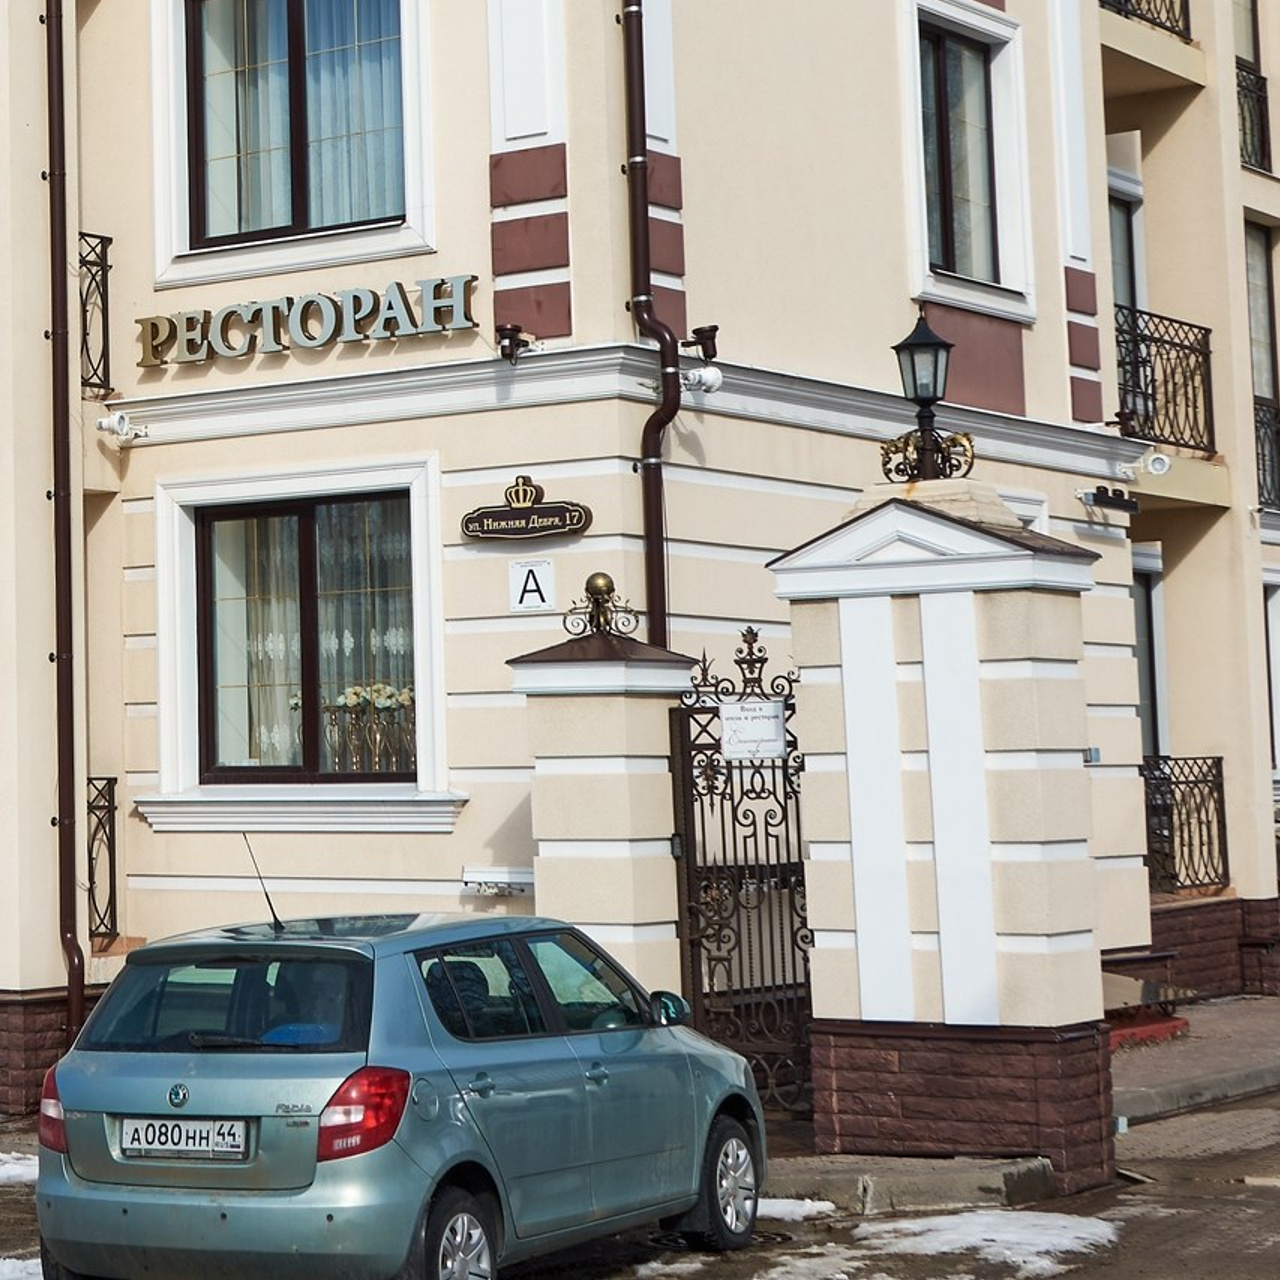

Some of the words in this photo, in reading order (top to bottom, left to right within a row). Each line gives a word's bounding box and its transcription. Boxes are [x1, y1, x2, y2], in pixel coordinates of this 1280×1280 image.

[135, 274, 480, 368] РЕСТОРАН
[565, 512, 580, 524] 17
[216, 1123, 237, 1142] 44
